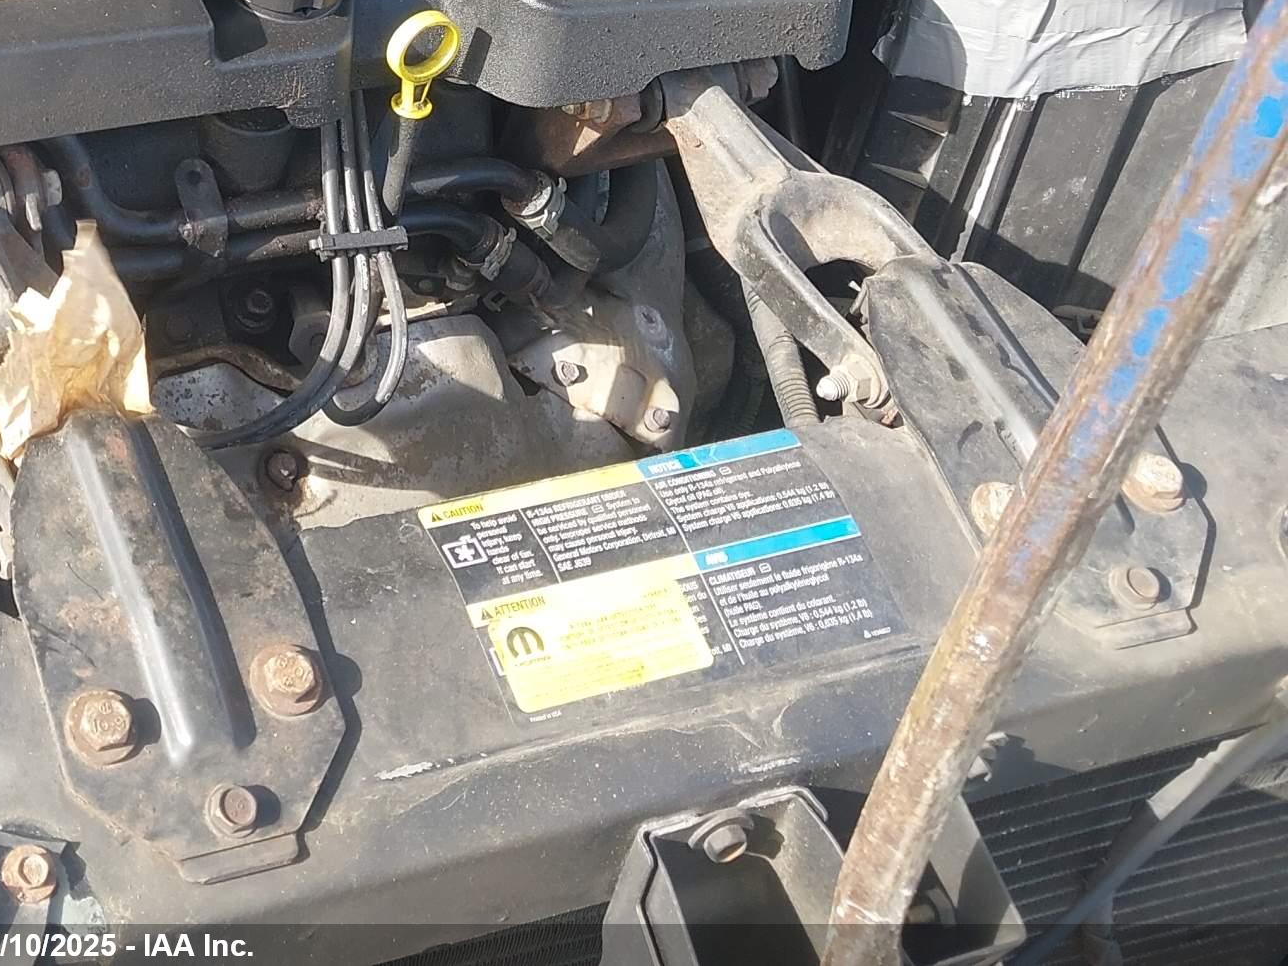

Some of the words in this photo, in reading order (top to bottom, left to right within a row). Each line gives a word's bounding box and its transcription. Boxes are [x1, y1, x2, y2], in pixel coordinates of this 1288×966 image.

[443, 503, 484, 519] CAUTION
[470, 522, 481, 530] To
[480, 519, 497, 528] help
[553, 549, 579, 561] General
[579, 545, 603, 555] Motors
[493, 596, 546, 616] ATTENTION
[734, 626, 759, 637] Charge
[739, 636, 764, 648] Charge
